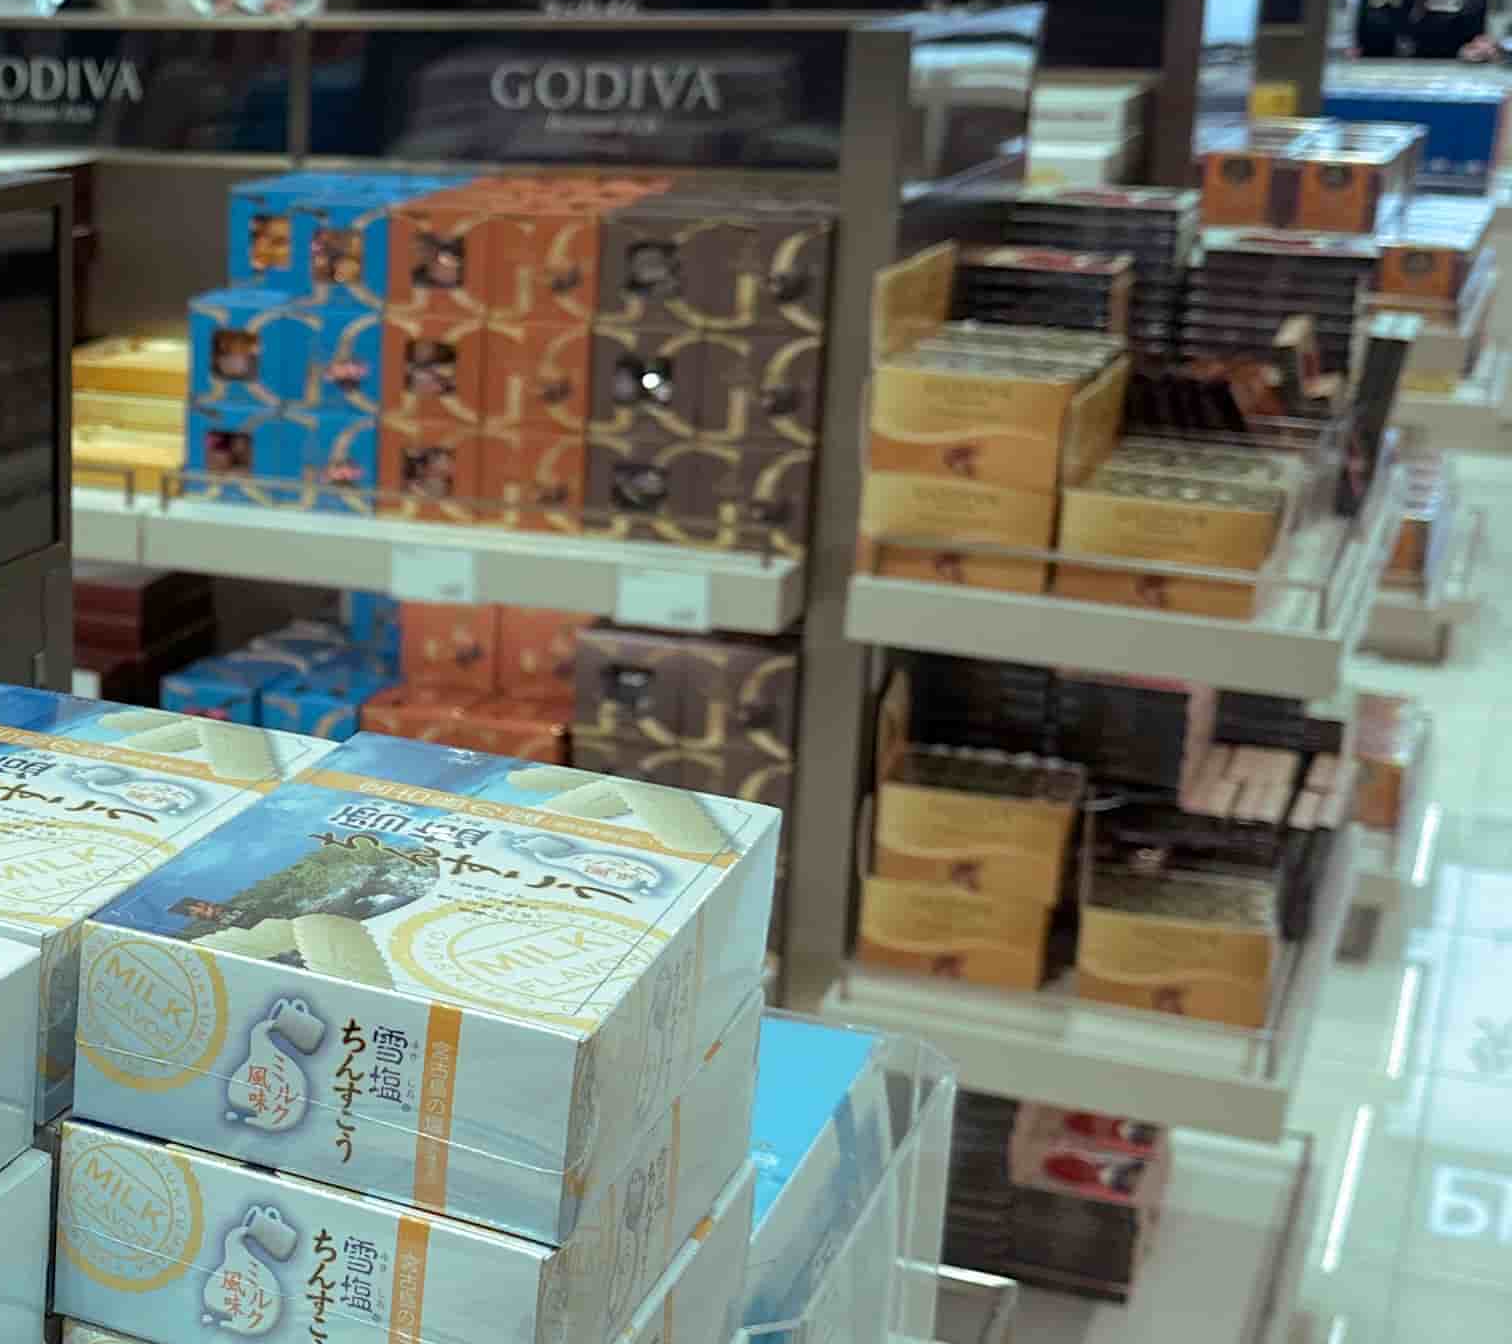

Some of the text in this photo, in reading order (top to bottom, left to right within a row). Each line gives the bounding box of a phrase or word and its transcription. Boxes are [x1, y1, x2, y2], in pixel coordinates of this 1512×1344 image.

[491, 64, 721, 111] GODIVA
[470, 930, 599, 979] MILK
[103, 955, 192, 1030] MILK
[334, 1018, 368, 1165] ちんすこう
[369, 1025, 410, 1105] 雪塩
[85, 1158, 165, 1226] MILK
[339, 1235, 379, 1315] 雪塩
